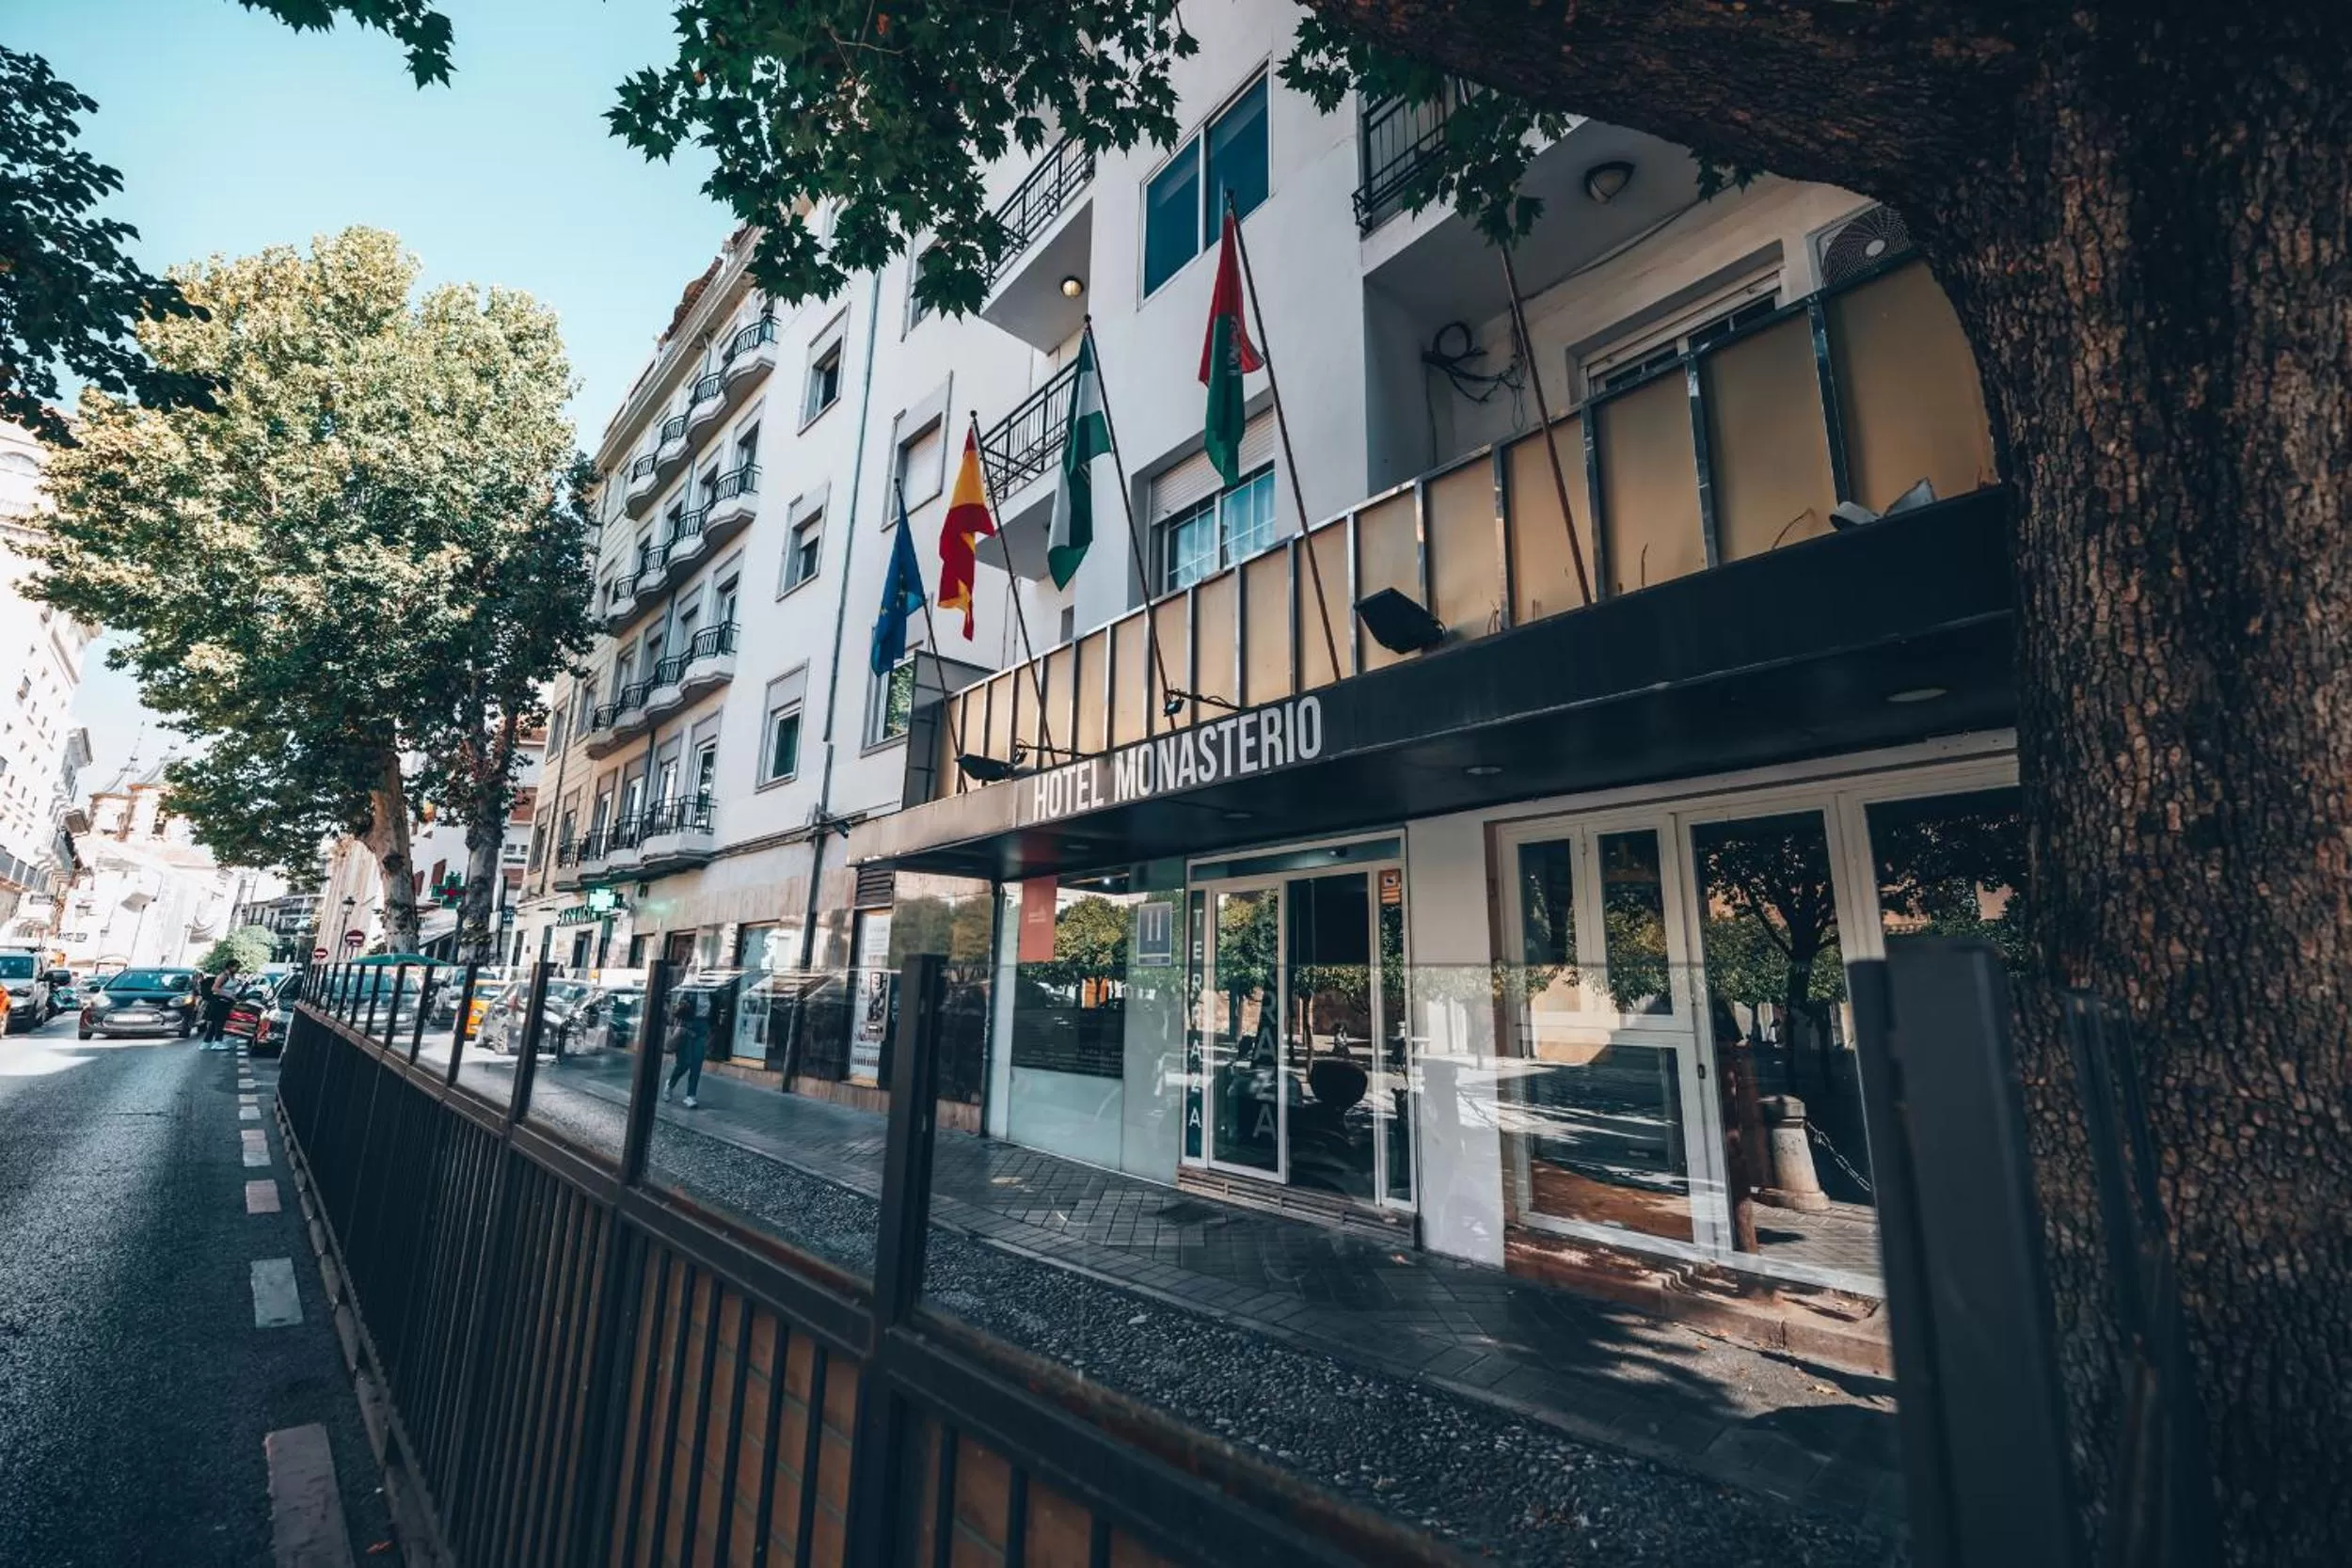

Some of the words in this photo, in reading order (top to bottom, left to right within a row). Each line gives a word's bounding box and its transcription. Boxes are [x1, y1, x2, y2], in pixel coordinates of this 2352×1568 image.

[1032, 760, 1104, 823] HOTEL
[1114, 695, 1323, 803] MONASTERIO
[1188, 908, 1203, 1129] TERRAZA
